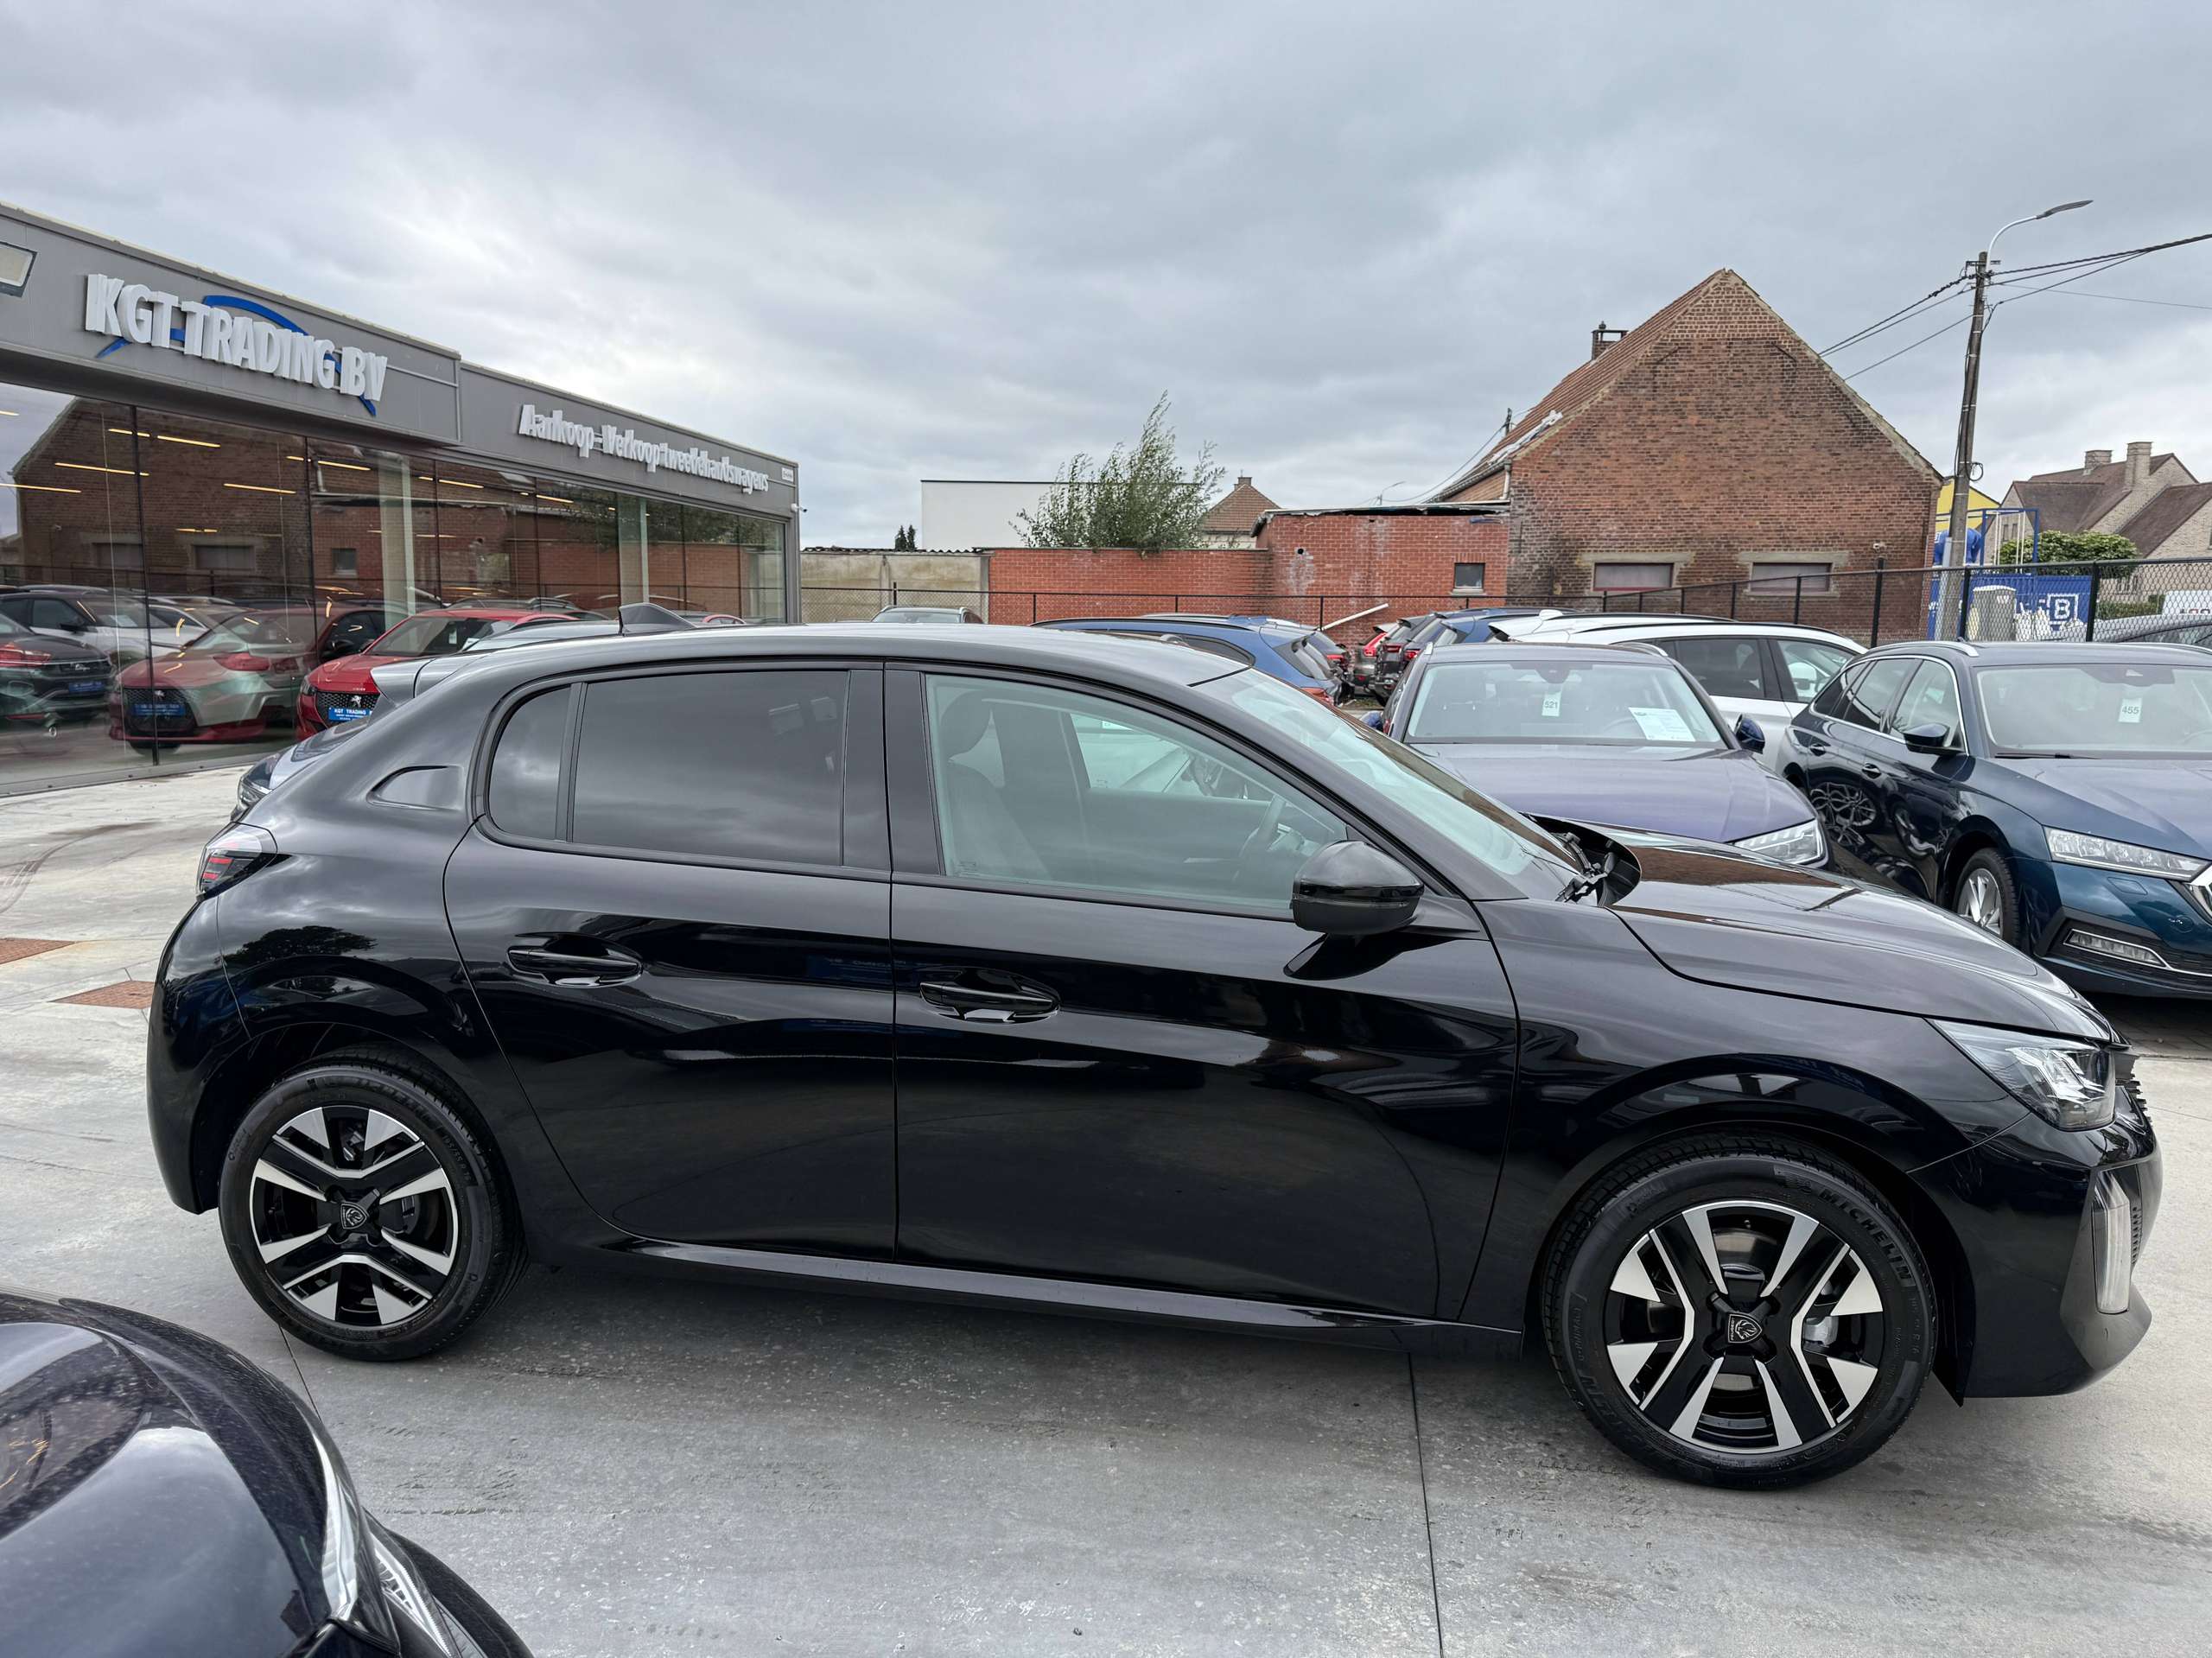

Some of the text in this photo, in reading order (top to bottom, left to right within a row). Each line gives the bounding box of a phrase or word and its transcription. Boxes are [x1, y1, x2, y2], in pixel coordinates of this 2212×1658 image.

[85, 273, 388, 402] KGT TRADING BV
[2121, 706, 2139, 715] 455
[1818, 1188, 1912, 1280] MICHELIN
